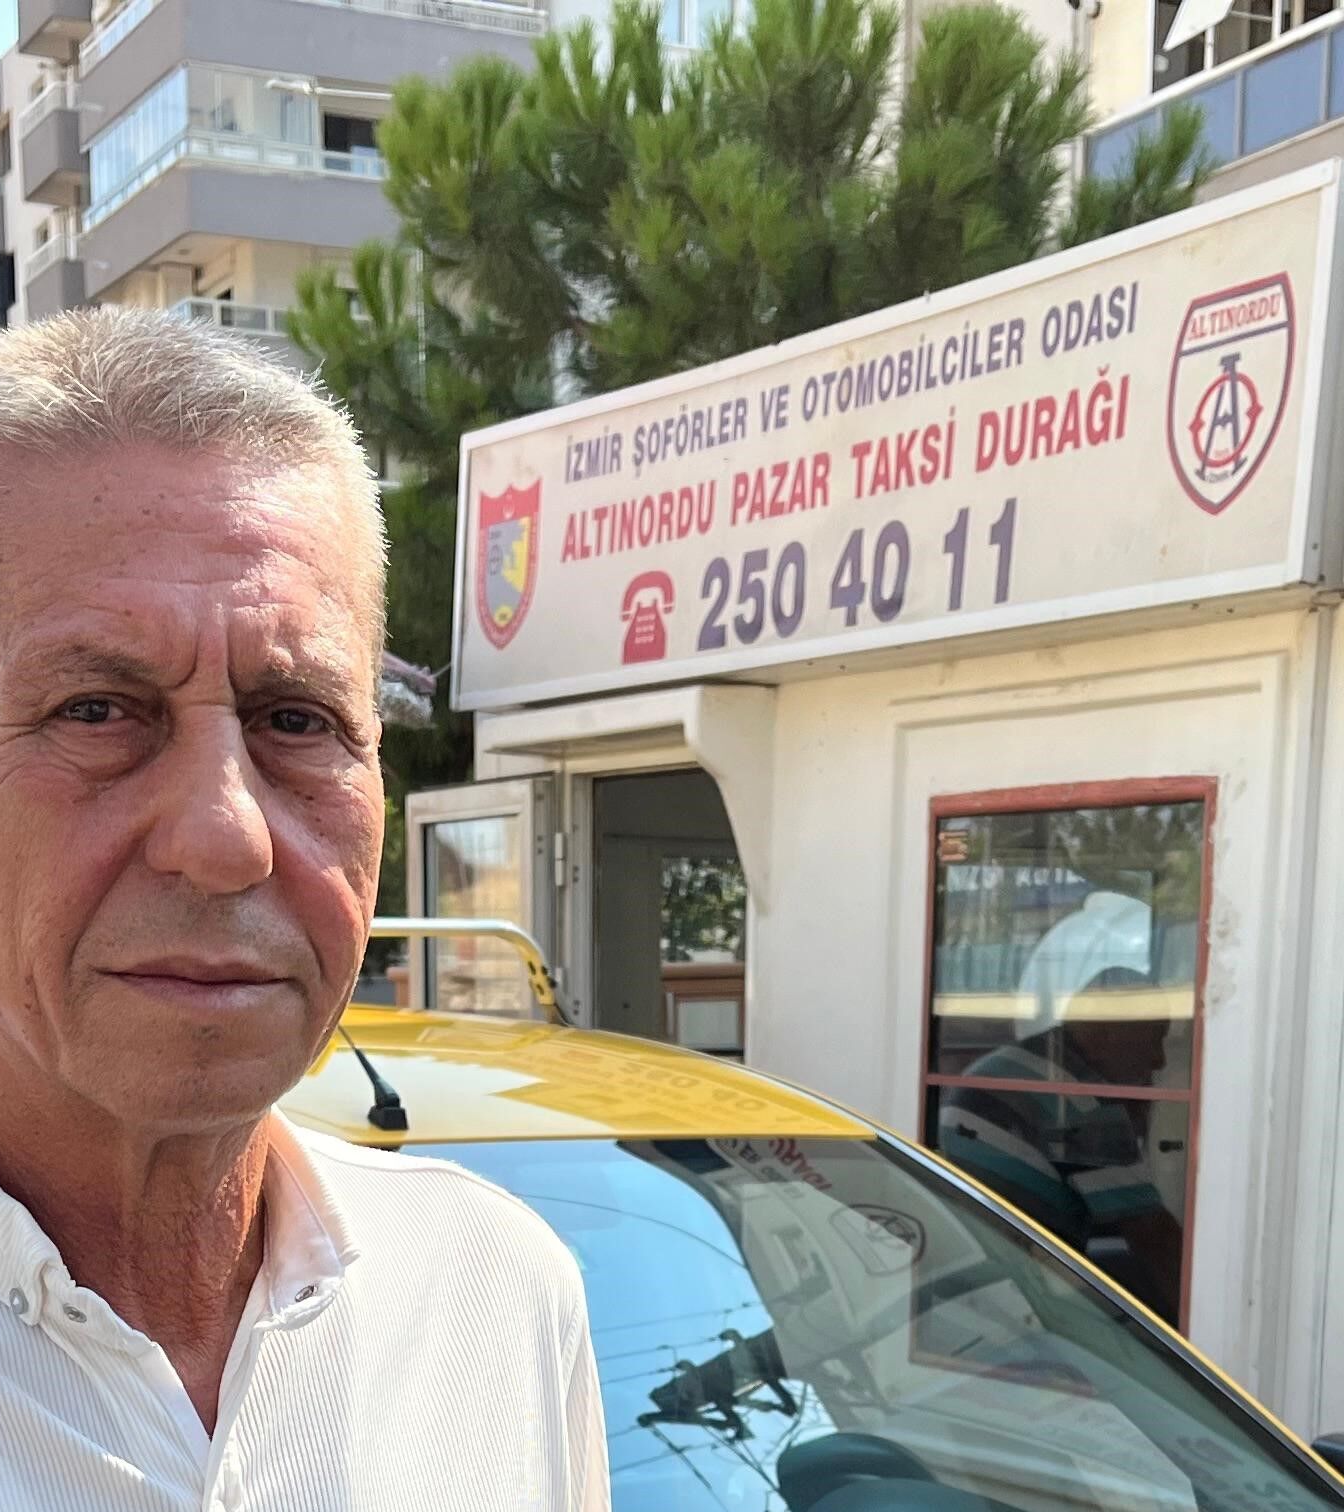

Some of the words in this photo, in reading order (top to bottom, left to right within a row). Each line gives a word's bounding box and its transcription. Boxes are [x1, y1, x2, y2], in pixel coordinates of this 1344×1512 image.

[566, 433, 622, 483] İZMİR
[633, 398, 747, 469] ŞOFÖRLER
[761, 384, 789, 432] VE
[802, 318, 1025, 422] OTOMOBİLCİLER
[1042, 282, 1138, 358] ODASI
[1187, 292, 1282, 341] ALTINORDU
[561, 480, 715, 563] ALTINORDU
[730, 452, 831, 526] PAZAR
[850, 406, 955, 499] TAKSİ
[975, 365, 1130, 473] DURAĞI
[696, 541, 806, 652] 250
[829, 520, 910, 627] 40
[943, 497, 1017, 611] 11
